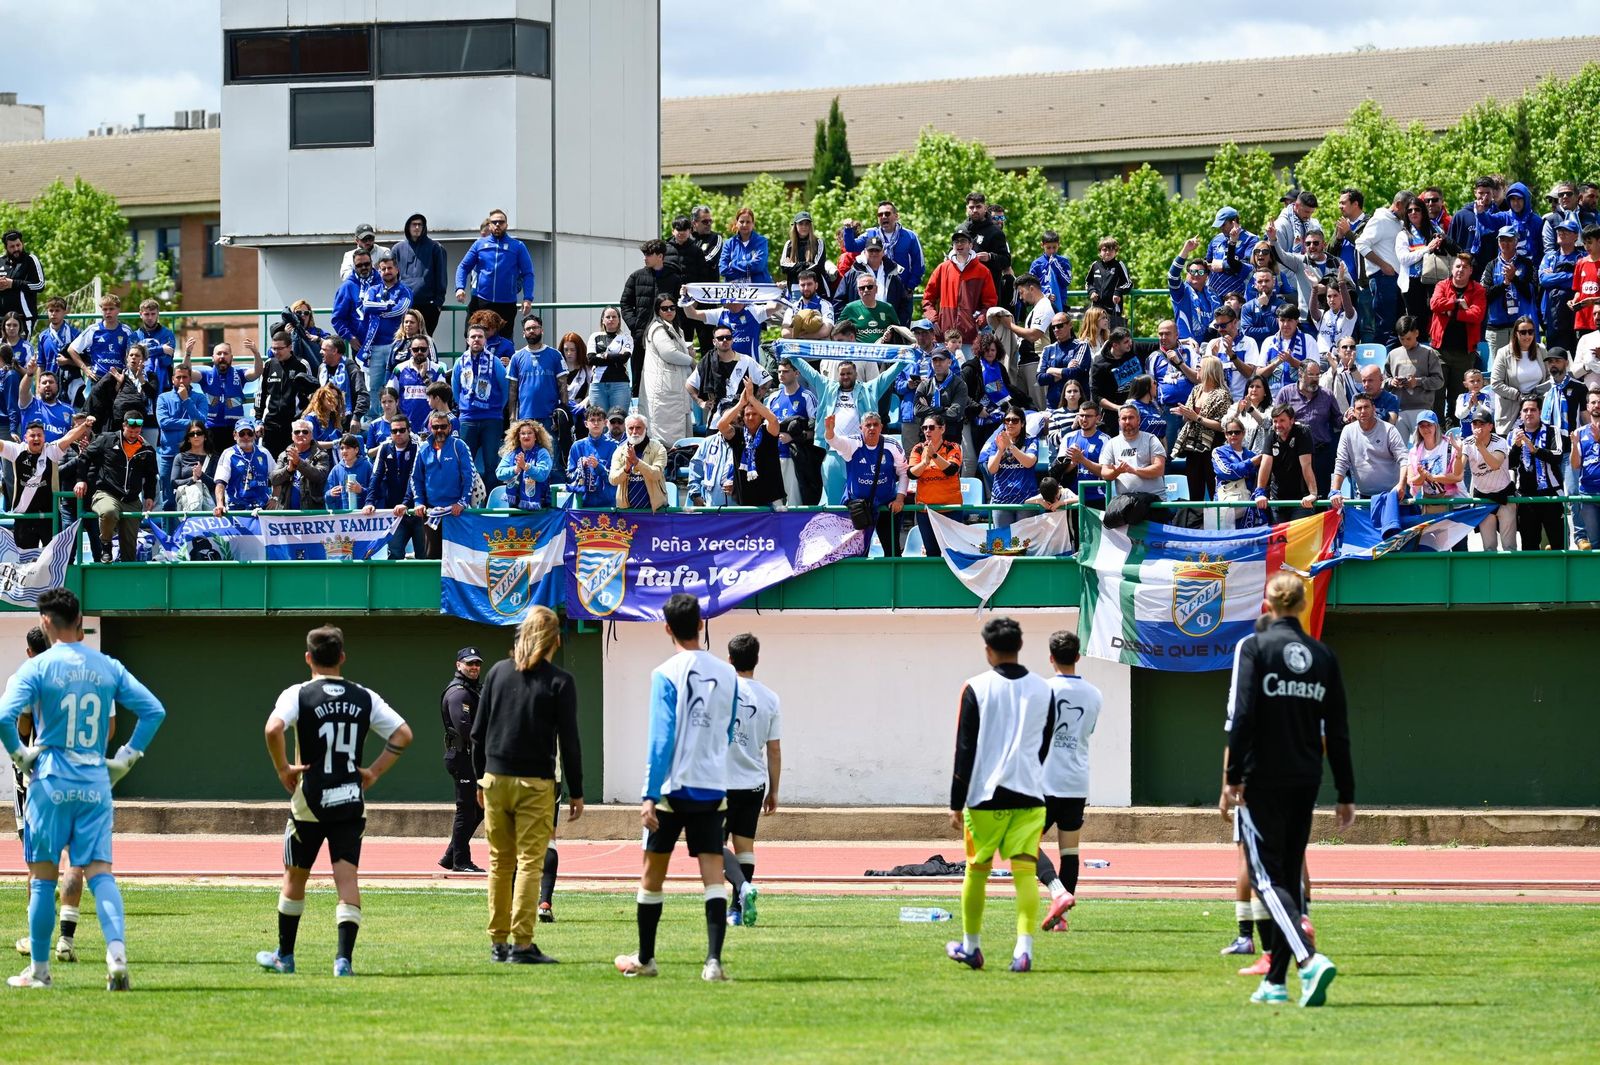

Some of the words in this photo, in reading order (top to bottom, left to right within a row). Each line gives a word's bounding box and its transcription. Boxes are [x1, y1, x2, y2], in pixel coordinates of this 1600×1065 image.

[701, 287, 759, 299] XEREZ
[268, 520, 336, 536] SHERRY
[340, 516, 398, 532] FAMILY
[651, 536, 691, 552] Peña
[698, 534, 775, 551] Xerecista
[495, 560, 526, 600] XEREZ
[635, 564, 706, 587] Rafa
[1180, 582, 1220, 620] XEREZ
[1168, 643, 1209, 657] QUE
[60, 692, 102, 748] 13
[314, 702, 362, 719] MISFFUT
[318, 722, 359, 774] 14
